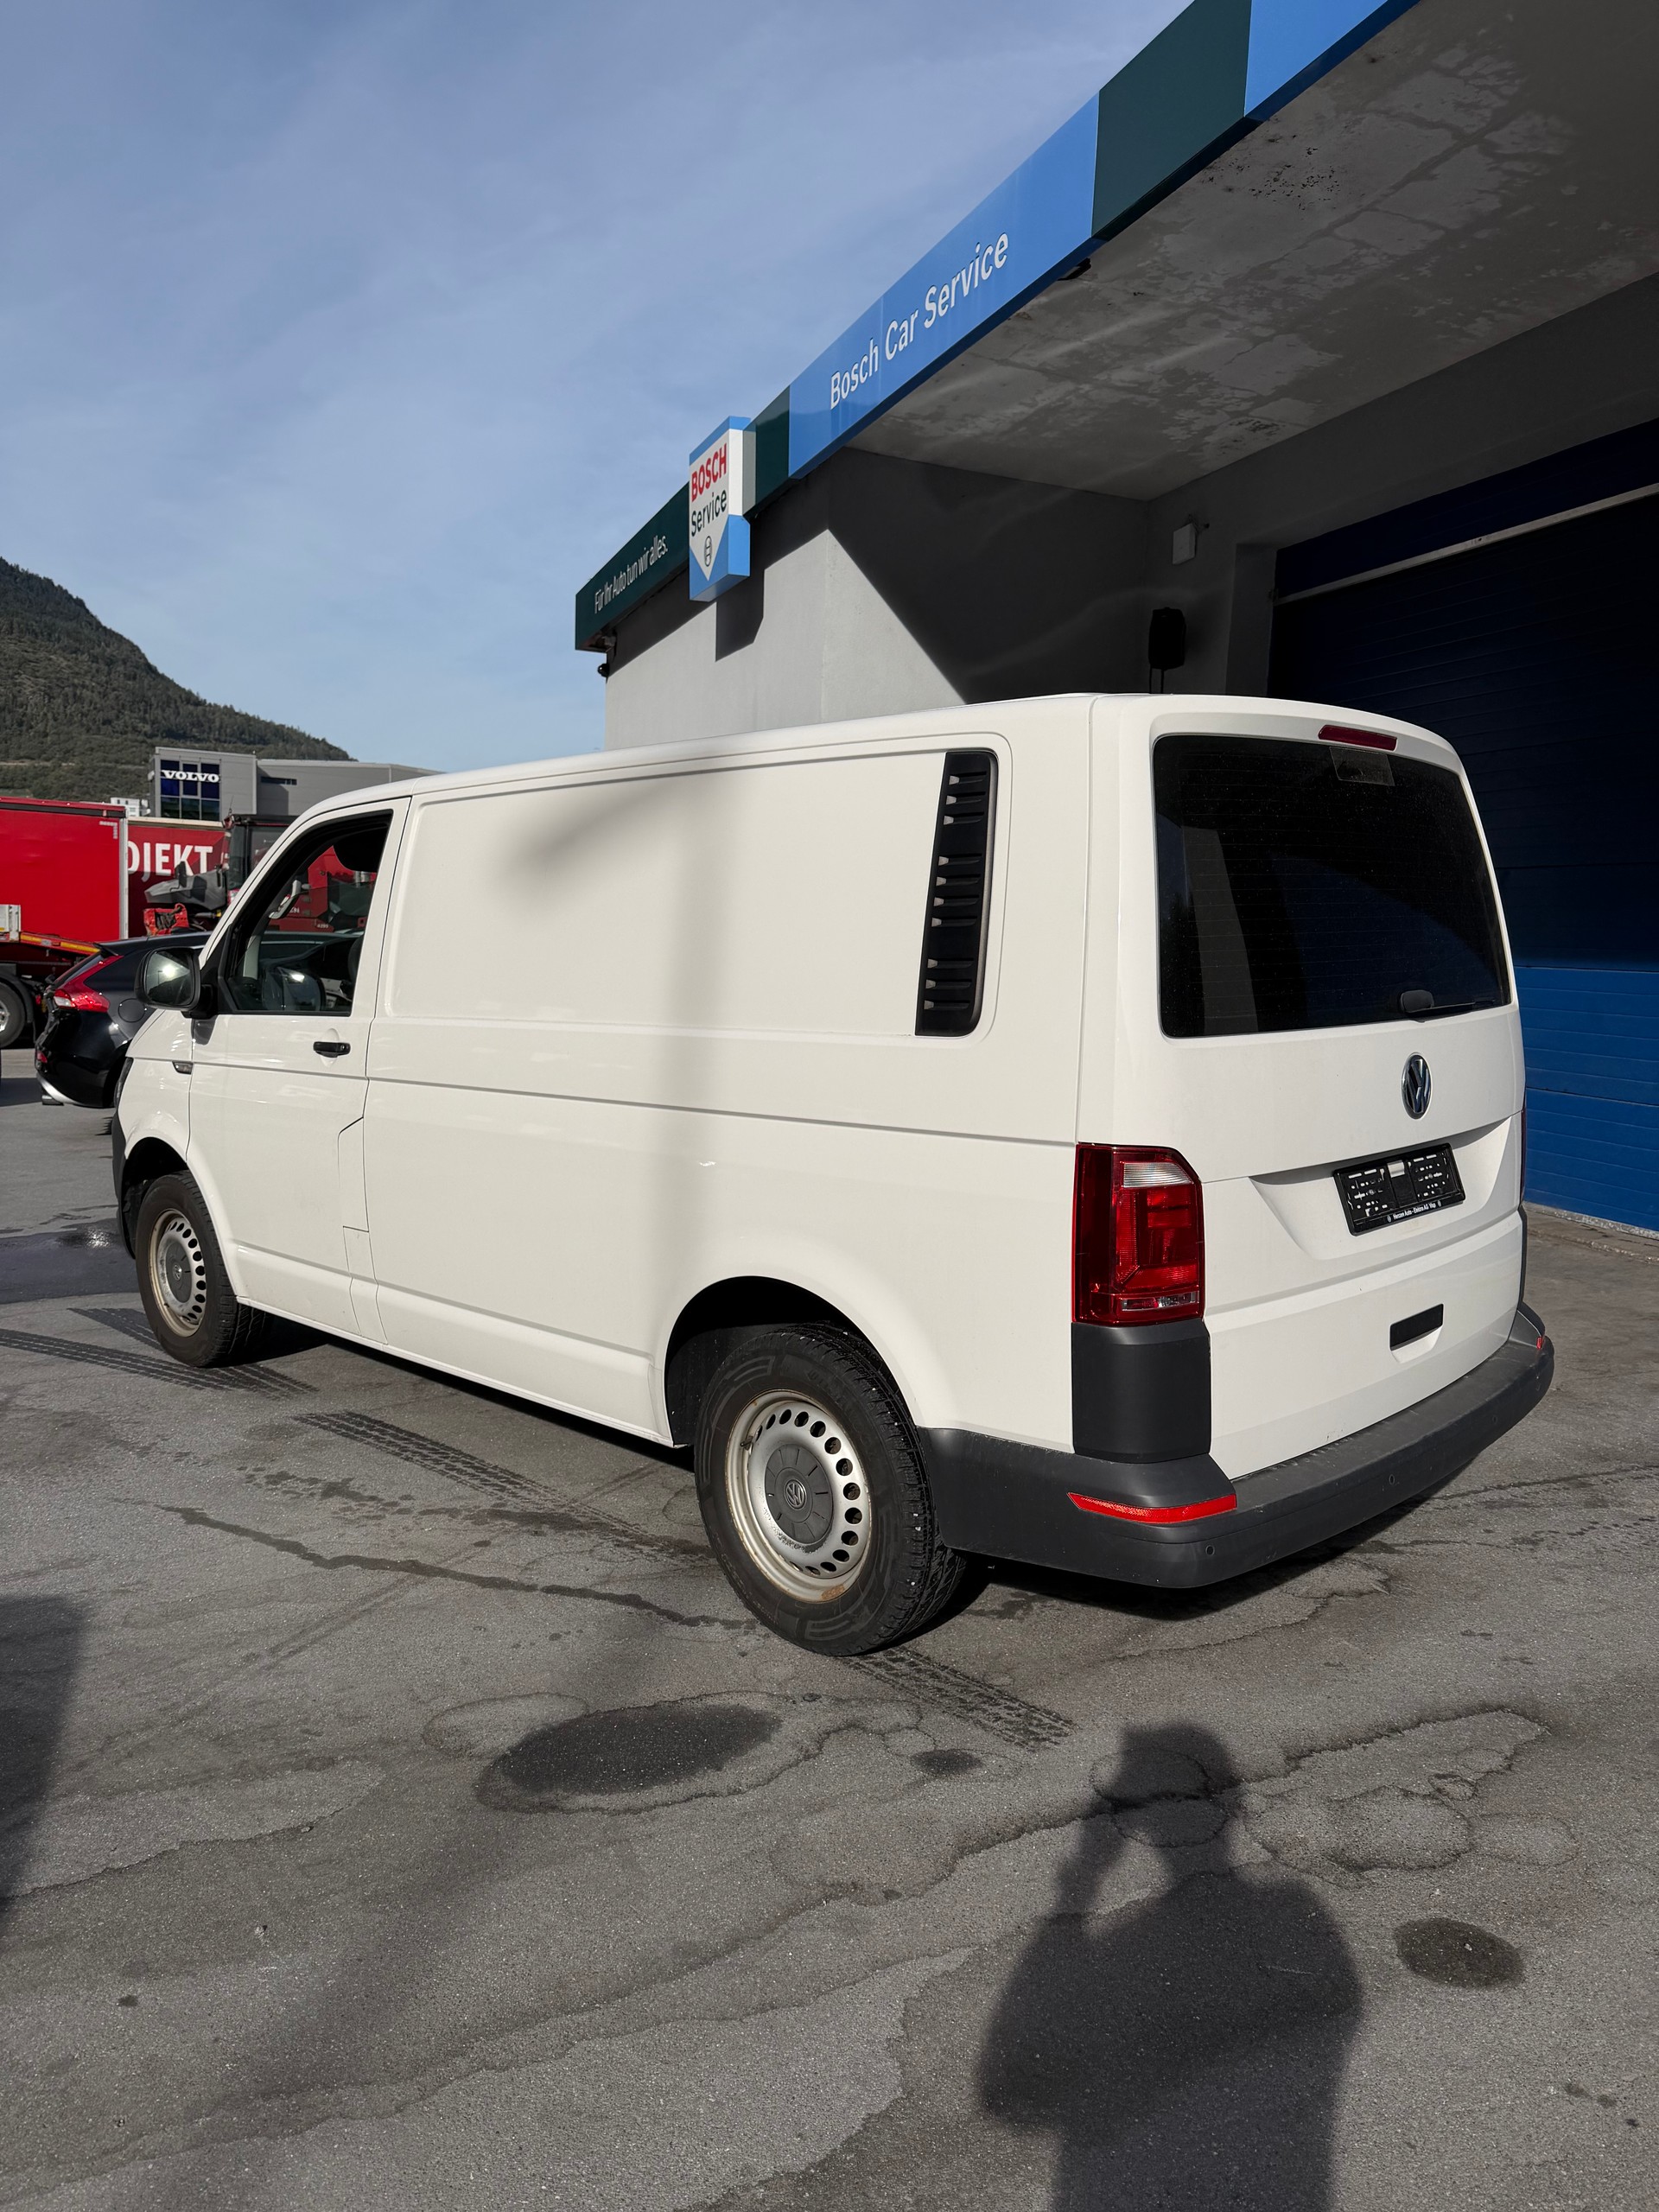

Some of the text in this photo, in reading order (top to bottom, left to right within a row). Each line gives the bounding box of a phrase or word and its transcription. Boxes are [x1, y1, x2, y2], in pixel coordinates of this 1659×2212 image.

[830, 232, 1008, 410] Bosch Car Service
[692, 443, 727, 502] BOSCH
[691, 489, 727, 537] Service
[613, 571, 626, 599] Auto
[626, 564, 638, 586] tun
[638, 547, 649, 575] wir
[649, 535, 668, 566] alles.
[161, 769, 219, 783] VOLVO
